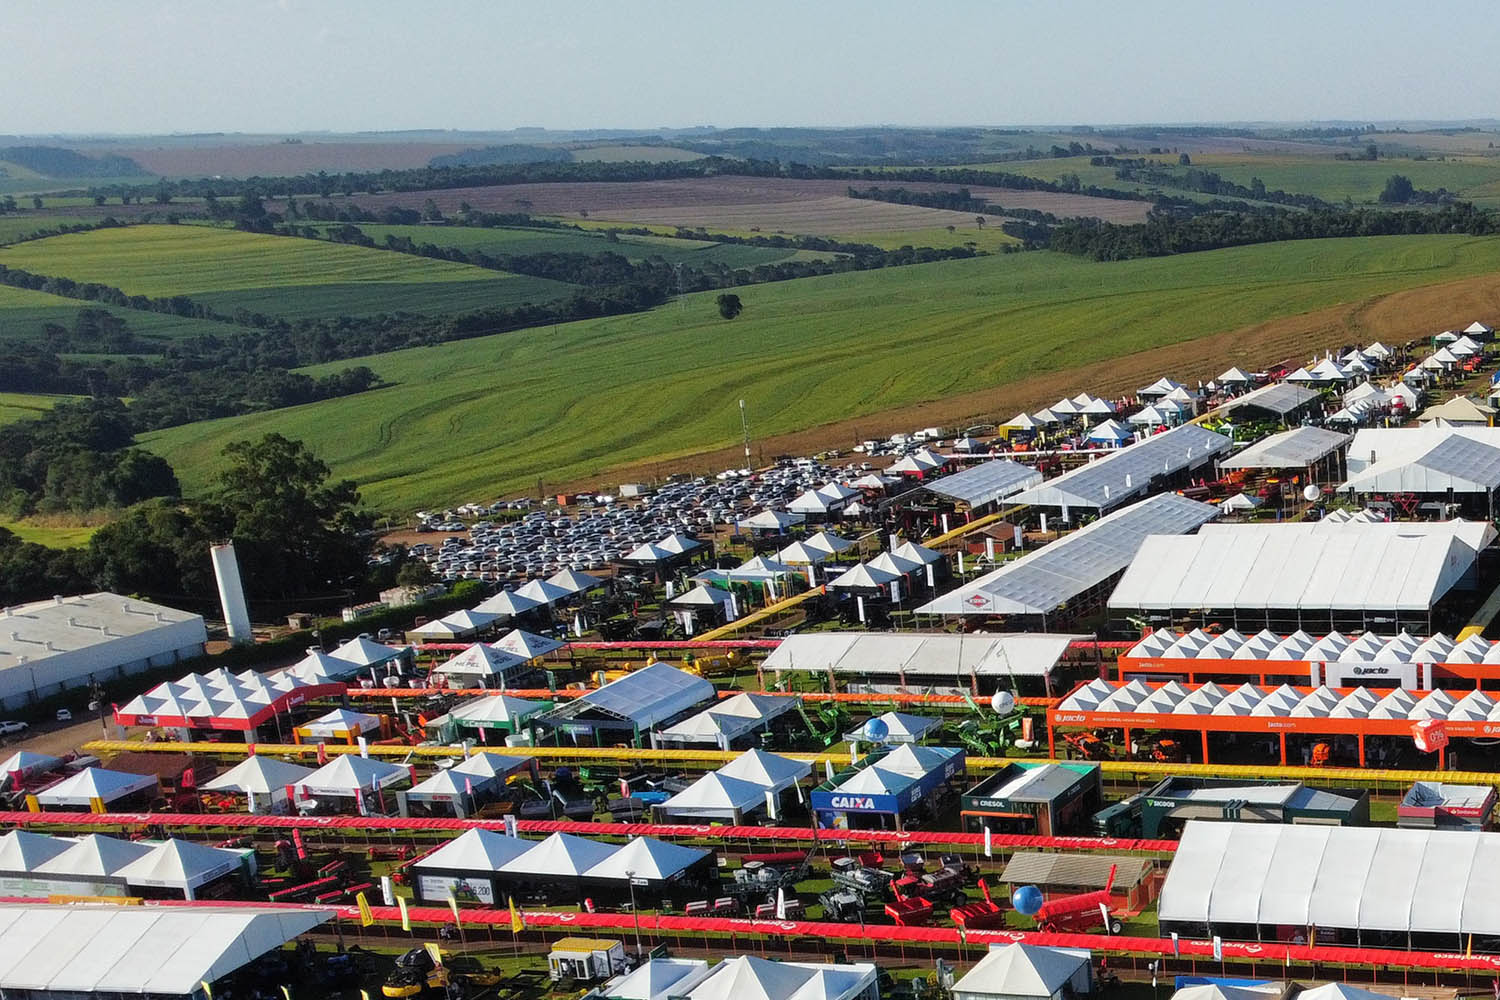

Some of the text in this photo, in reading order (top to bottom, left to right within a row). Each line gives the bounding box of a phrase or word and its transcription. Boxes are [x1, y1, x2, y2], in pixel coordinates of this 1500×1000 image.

[1362, 666, 1390, 675] jacto
[1061, 714, 1086, 722] jacto
[831, 796, 874, 809] CAIXA
[980, 798, 1004, 808] CRESOL
